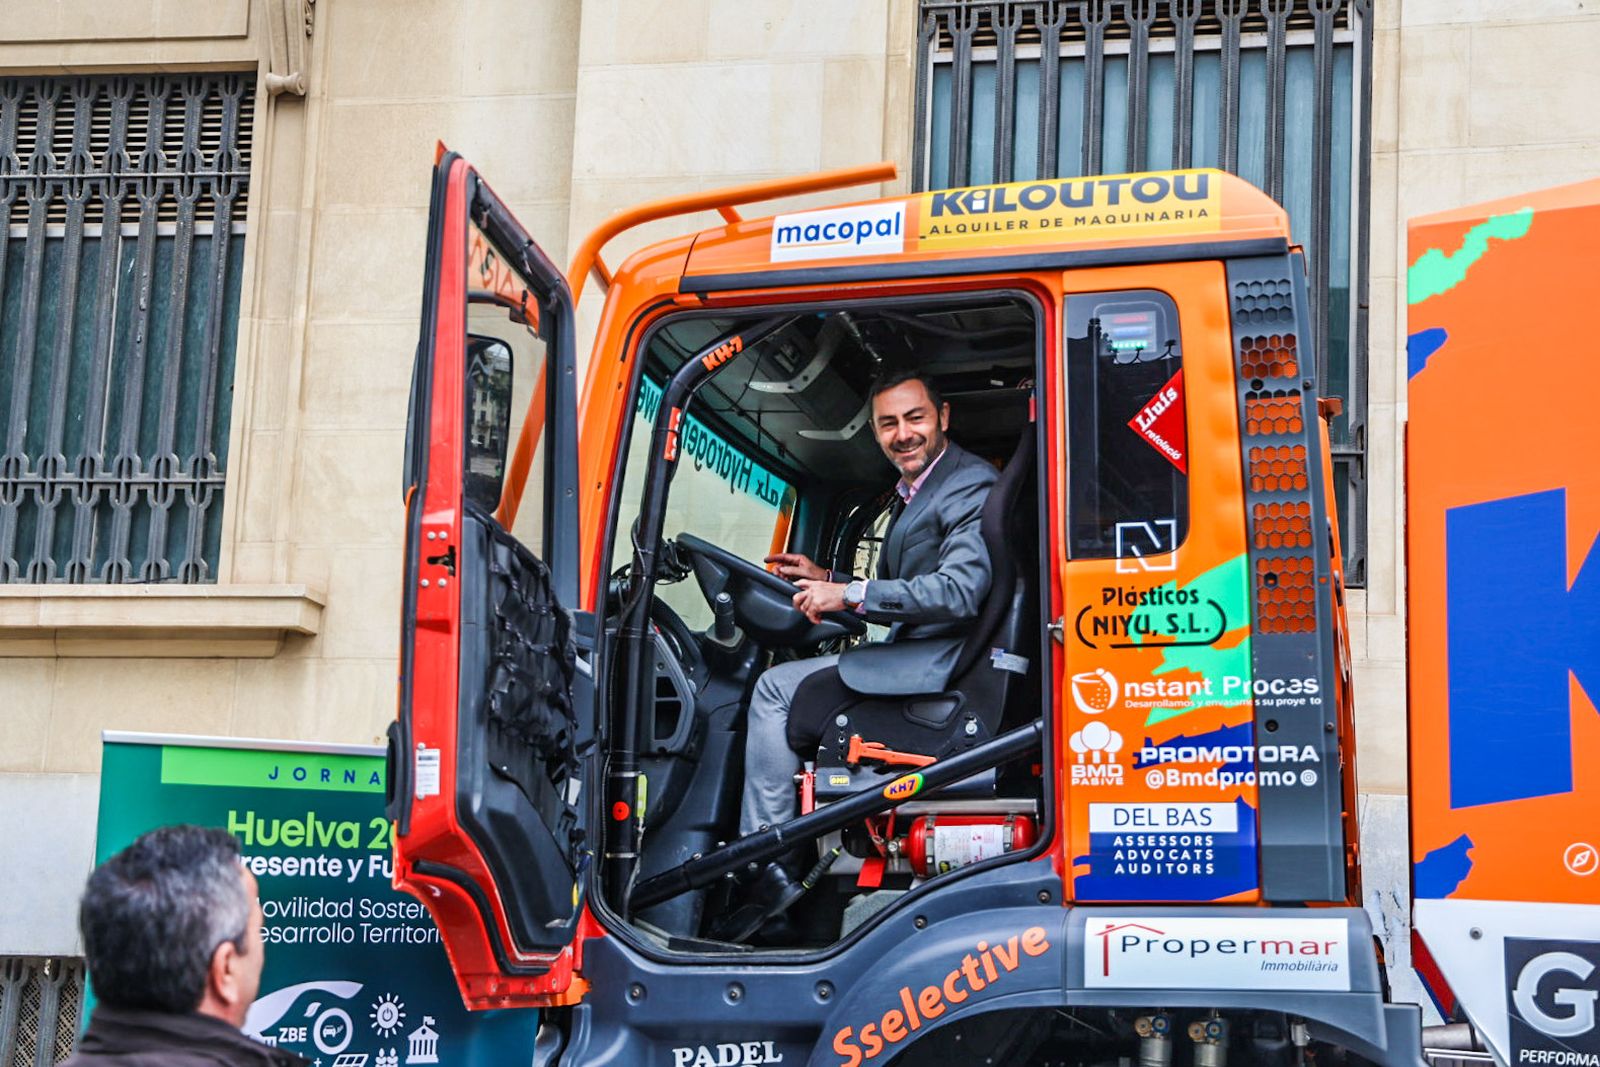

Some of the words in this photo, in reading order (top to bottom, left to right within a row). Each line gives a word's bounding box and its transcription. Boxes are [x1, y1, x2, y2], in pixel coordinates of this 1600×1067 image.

[777, 211, 901, 245] macopal
[929, 220, 1029, 236] ALQUILER
[1040, 218, 1064, 230] DE
[1074, 208, 1209, 226] MAQUINARIA
[1135, 386, 1178, 432] Lluís
[1145, 429, 1182, 460] retolació
[1102, 586, 1200, 606] Plásticos
[1093, 613, 1158, 637] NIYU,
[1167, 613, 1210, 634] S.L.
[1125, 699, 1194, 708] Desarrollamos
[1262, 698, 1274, 706] su
[1141, 745, 1320, 763] PROMOTORA
[268, 766, 381, 785] JORNA
[1071, 764, 1123, 778] BMD
[1145, 769, 1297, 790] @Bmdpromo
[889, 779, 916, 795] KH7
[1113, 808, 1159, 826] DEL
[1166, 807, 1213, 826] BAS
[228, 810, 360, 848] Huelva
[1114, 835, 1214, 846] ASSESSORS
[1114, 849, 1214, 860] ADVOCATS
[242, 854, 343, 877] resente
[348, 859, 363, 883] y
[1115, 863, 1214, 874] AUDITORS
[256, 896, 353, 918] ovilidad
[260, 923, 355, 943] esarrollo
[360, 923, 445, 944] Territori
[1121, 934, 1338, 958] Propermar
[1260, 960, 1339, 973] Immobiliària
[278, 1027, 307, 1042] ZBE
[672, 1041, 784, 1067] PADEL
